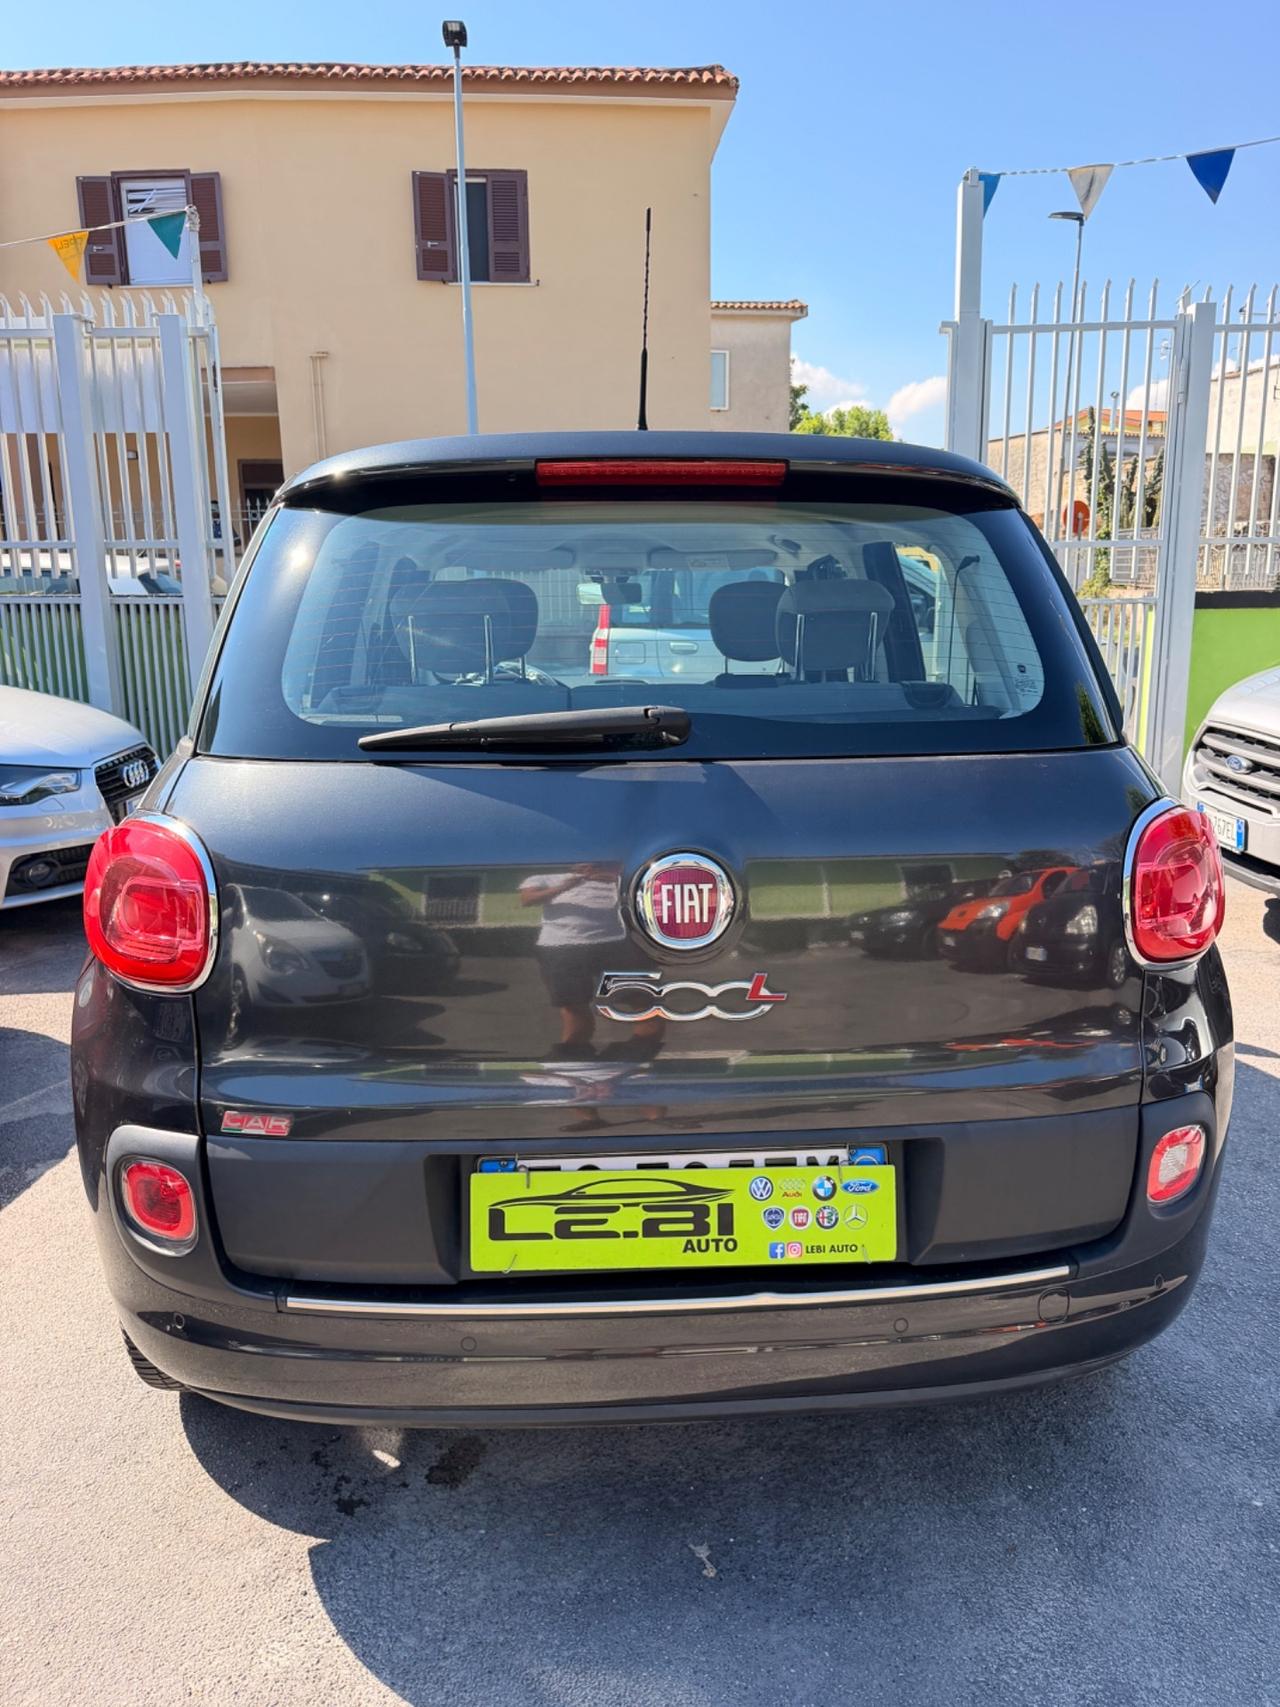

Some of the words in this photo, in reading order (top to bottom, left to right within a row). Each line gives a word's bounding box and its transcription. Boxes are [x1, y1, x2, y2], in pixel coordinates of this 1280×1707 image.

[661, 883, 714, 924] FIAT
[596, 971, 787, 1021] 500L
[224, 1113, 290, 1130] CAR
[682, 1237, 738, 1253] AUTO
[805, 1244, 826, 1254] LEBI
[829, 1243, 858, 1253] AUTO
